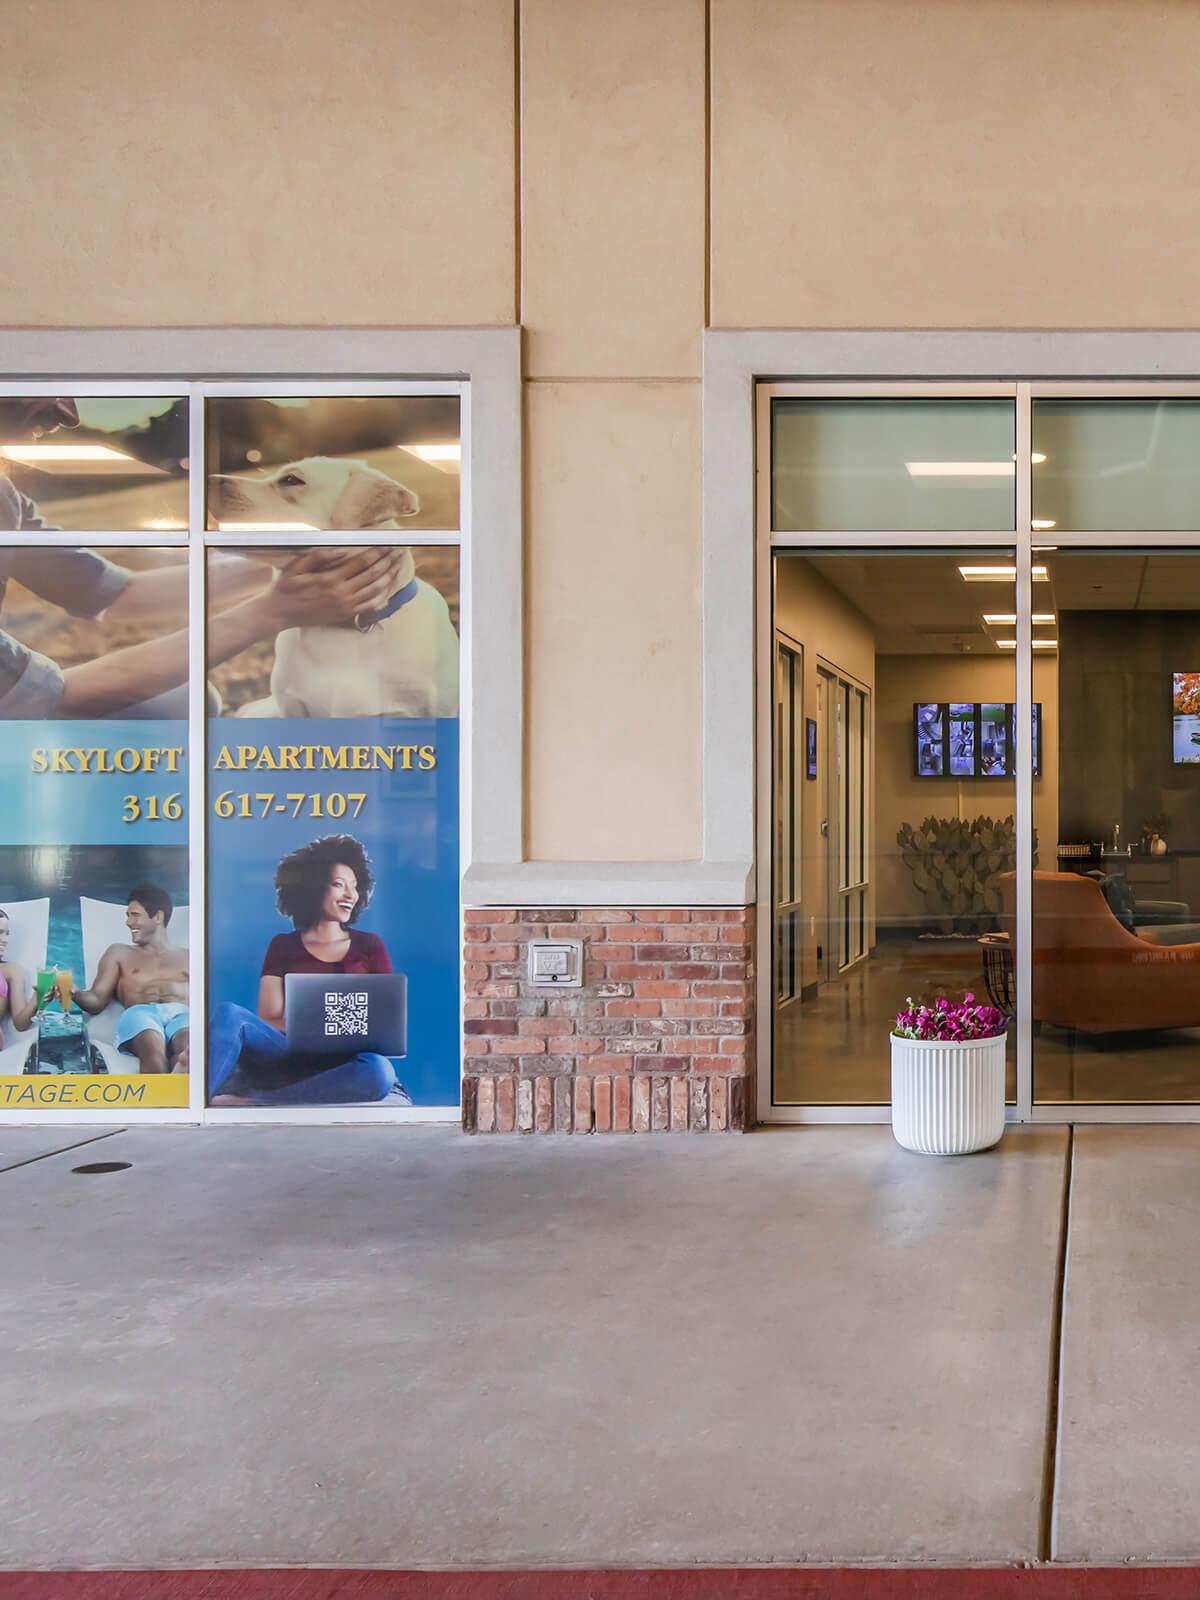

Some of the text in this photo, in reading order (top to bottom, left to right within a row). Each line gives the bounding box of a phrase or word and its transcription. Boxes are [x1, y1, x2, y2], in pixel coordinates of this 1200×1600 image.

[31, 745, 437, 772] SKYLOFT APARTMENTS
[122, 790, 367, 822] 316 617-7107
[0, 1084, 146, 1103] TAGE.COM
